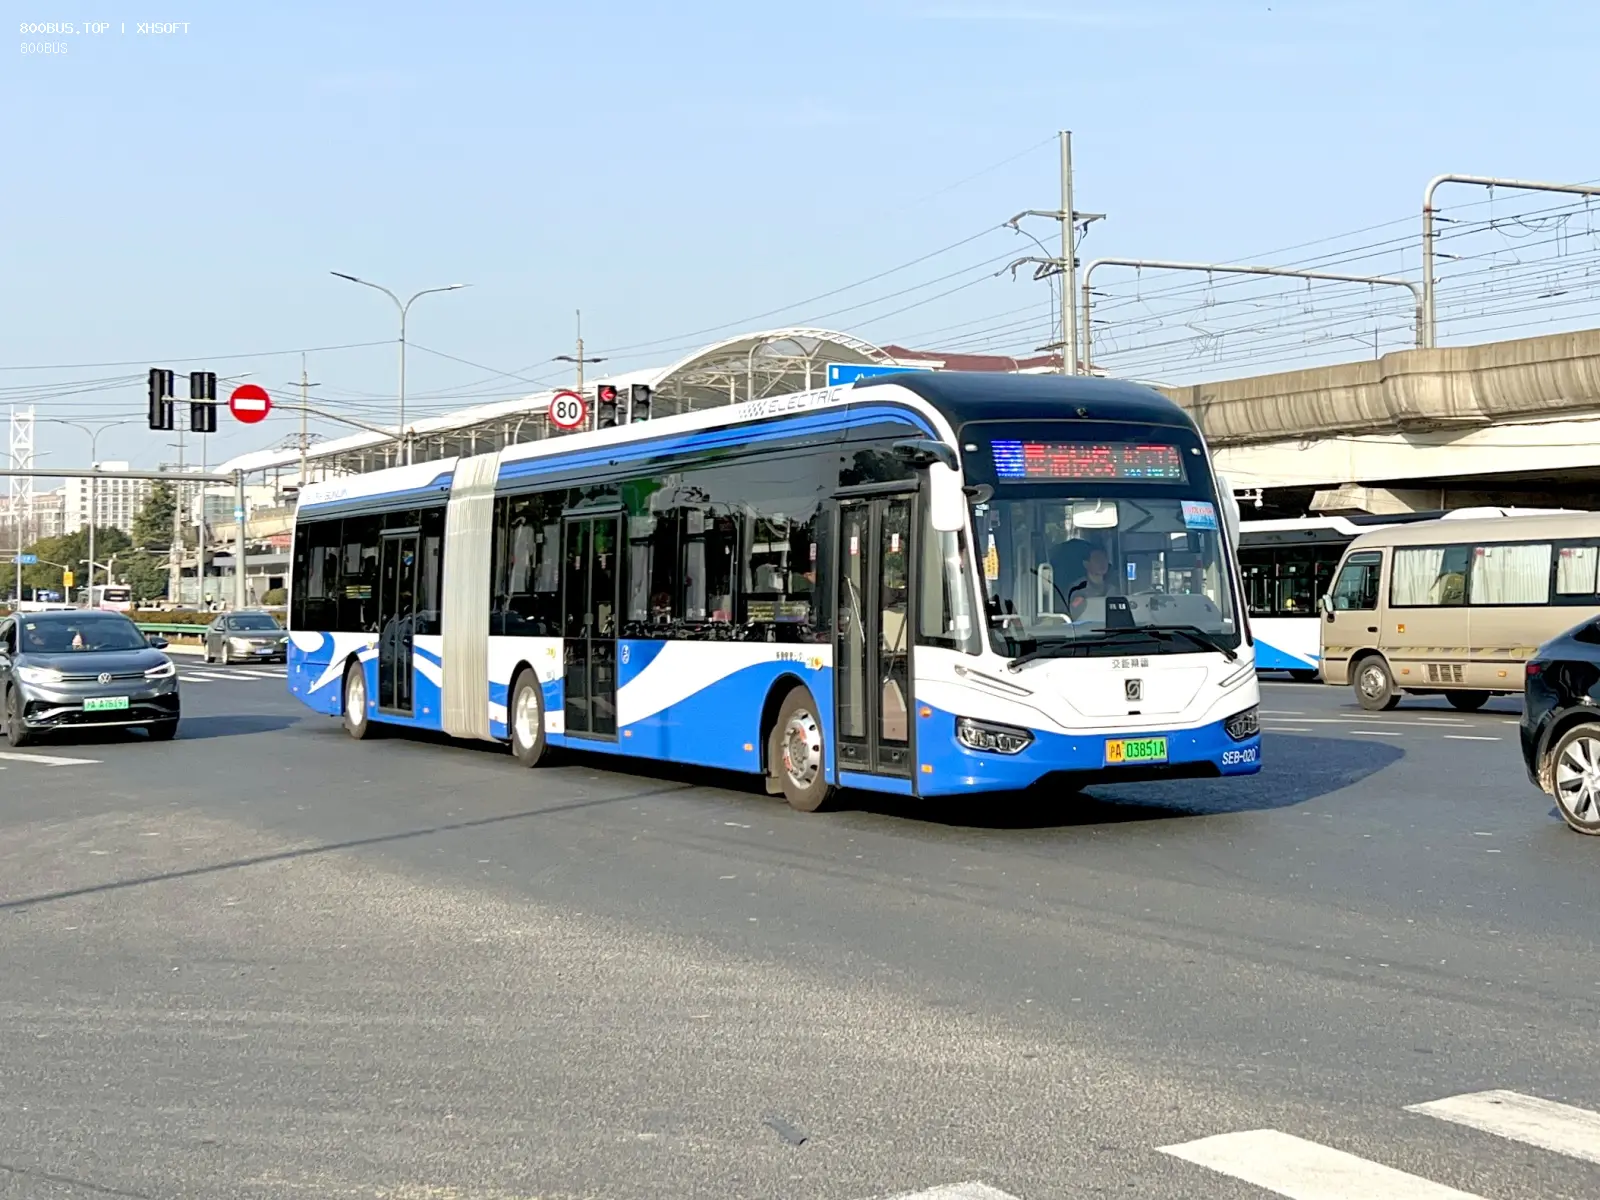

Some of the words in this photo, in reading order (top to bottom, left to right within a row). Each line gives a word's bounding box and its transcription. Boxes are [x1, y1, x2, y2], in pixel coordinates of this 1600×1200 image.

[768, 388, 843, 413] ELECTRIC
[557, 401, 578, 419] 80
[1126, 740, 1166, 758] 03851A
